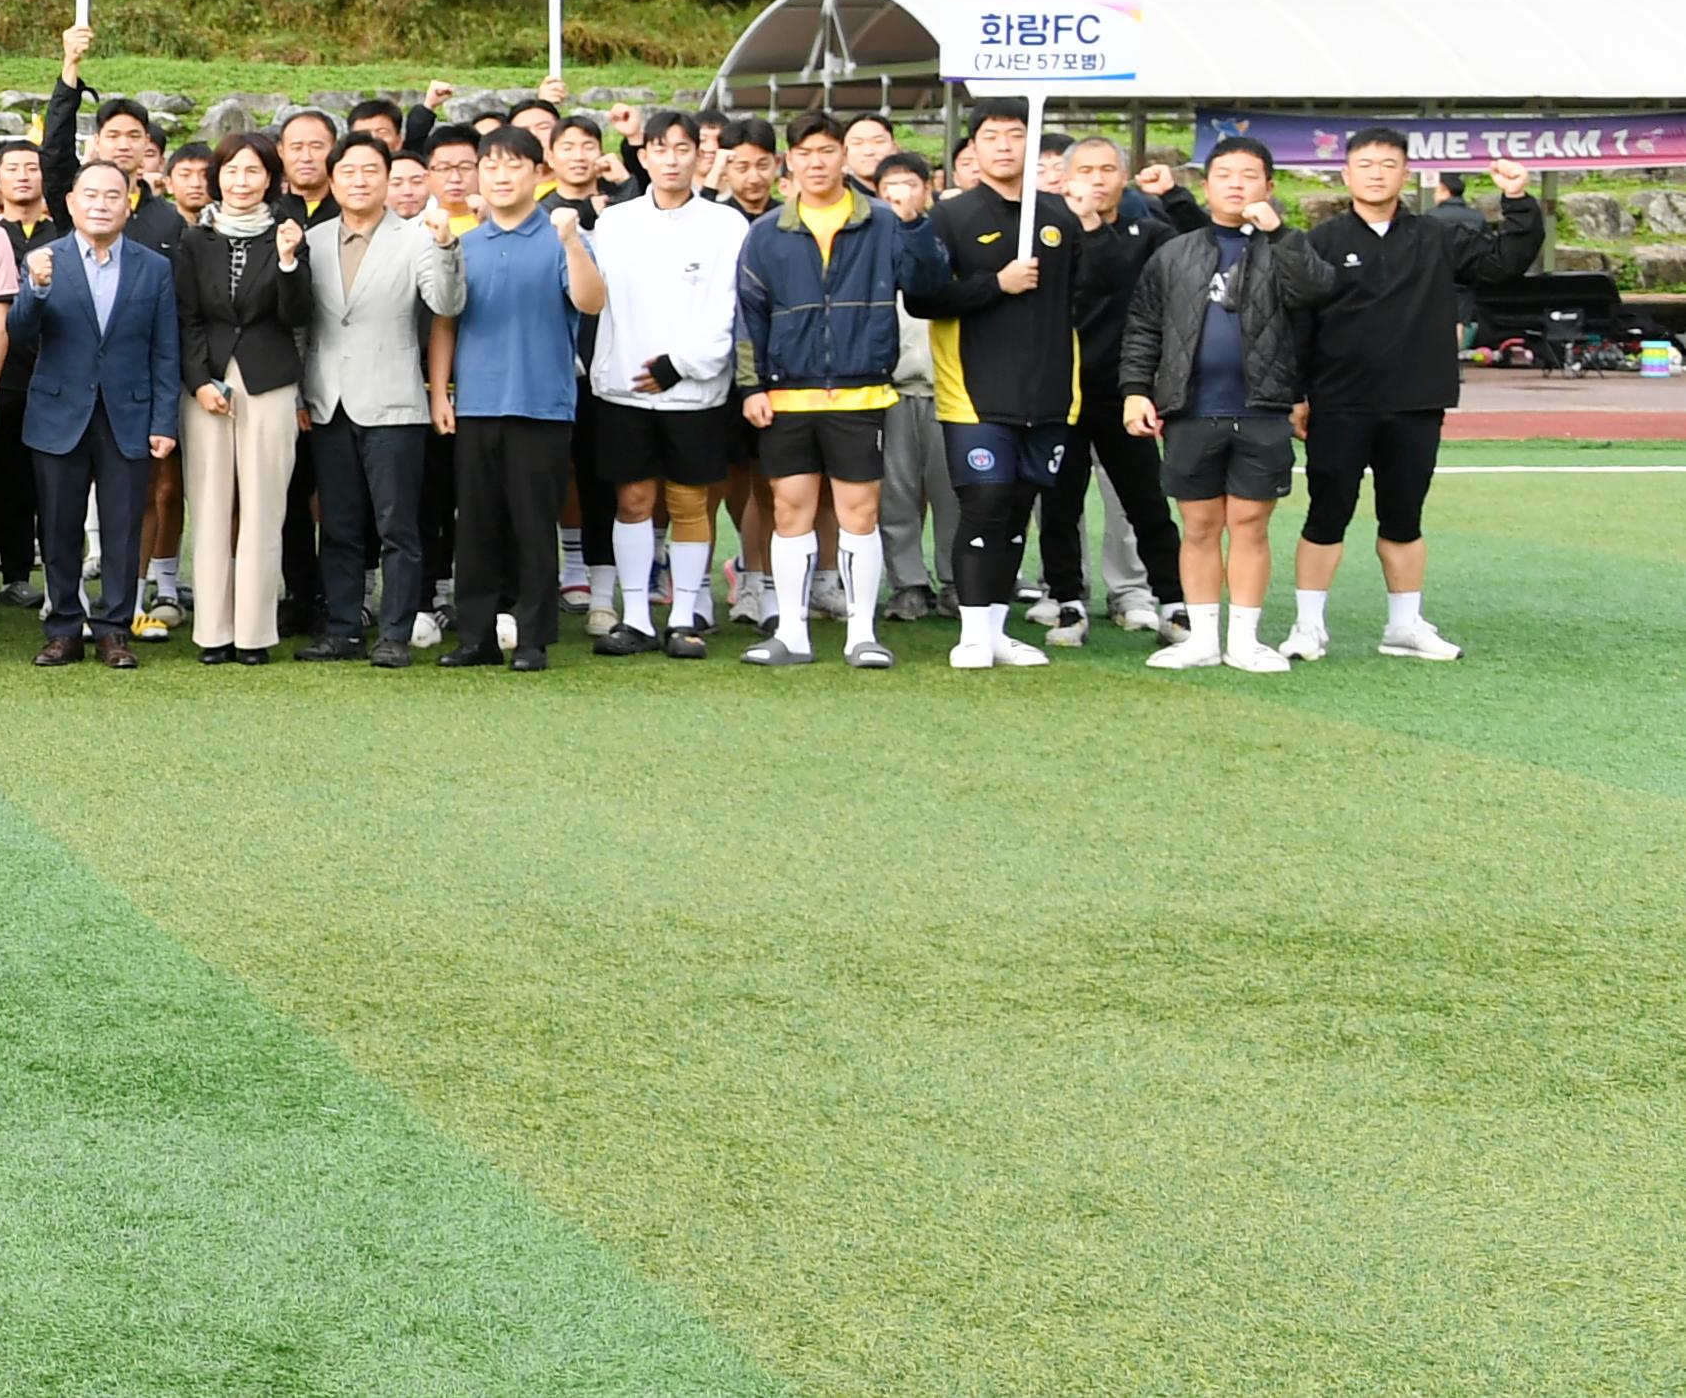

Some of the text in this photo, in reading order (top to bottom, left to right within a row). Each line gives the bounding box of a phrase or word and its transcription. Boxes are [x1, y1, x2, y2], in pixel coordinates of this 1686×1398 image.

[980, 13, 1101, 46] 화랑FC
[974, 52, 1106, 71] (7사단 57포병)
[1480, 129, 1602, 159] TEAM
